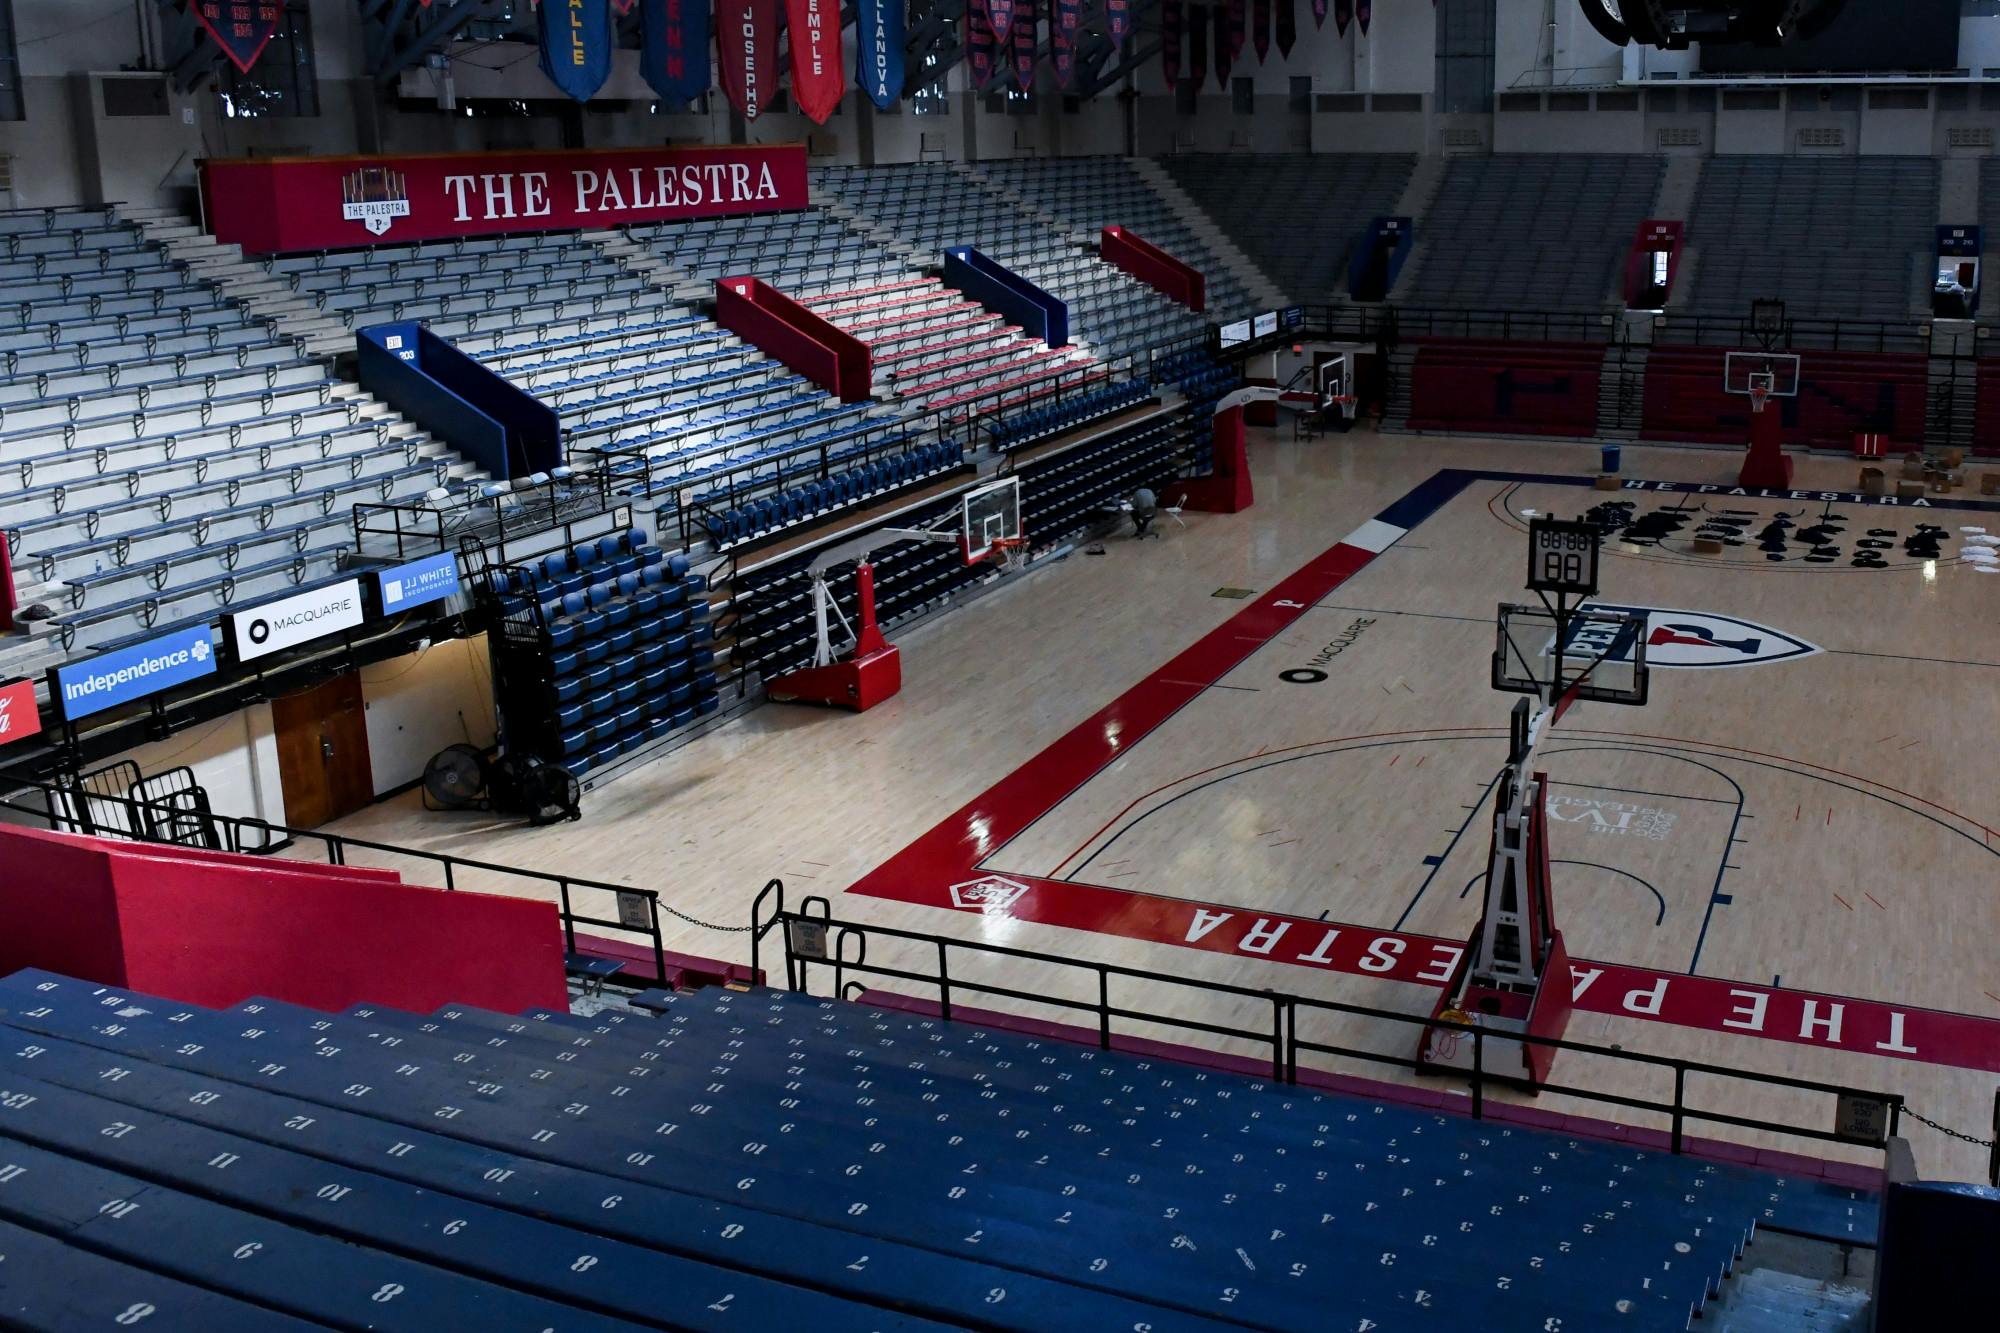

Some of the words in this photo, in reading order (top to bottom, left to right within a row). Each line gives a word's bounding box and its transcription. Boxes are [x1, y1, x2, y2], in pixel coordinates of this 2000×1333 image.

[444, 171, 551, 222] THE
[571, 161, 779, 214] PALESTRA
[348, 205, 363, 217] THE
[366, 203, 406, 216] PALESTRA
[375, 219, 382, 231] P
[1698, 484, 1933, 507] PALESTRA
[404, 576, 417, 590] JJ
[419, 566, 452, 584] WHITE
[404, 578, 454, 598] INCORPORATED
[273, 598, 352, 632] MACQUARIE
[1567, 608, 1630, 656] PEN
[1306, 617, 1377, 667] MACQUARIE
[65, 648, 189, 701] Independence
[1184, 907, 1671, 1017] PAESTRA
[1722, 989, 1920, 1055] THE
[17, 1046, 46, 1058] 15
[99, 1068, 130, 1081] 14
[344, 1084, 372, 1096] 13
[2, 1094, 37, 1108] 13
[189, 1091, 220, 1104] 13
[435, 1106, 463, 1118] 12
[101, 1122, 136, 1137] 12
[285, 1116, 316, 1129] 12
[387, 1142, 415, 1156] 11
[208, 1153, 240, 1168] 11
[627, 1152, 655, 1165] 10
[0, 1165, 26, 1182] 11
[484, 1168, 515, 1182] 10
[737, 1178, 755, 1189] 9
[317, 1184, 352, 1201] 10
[948, 1187, 966, 1198] 8
[602, 1195, 622, 1208] 9
[100, 1200, 139, 1218] 10
[848, 1203, 868, 1215] 8
[443, 1220, 467, 1235] 9
[721, 1224, 744, 1238] 8
[964, 1231, 982, 1243] 7
[1170, 1235, 1187, 1249] 6
[234, 1243, 262, 1259] 9
[571, 1256, 598, 1272] 8
[847, 1256, 869, 1271] 7
[1090, 1258, 1107, 1271] 6
[1290, 1263, 1307, 1276] 5
[372, 1284, 404, 1302] 8
[985, 1288, 1005, 1303] 6
[1220, 1288, 1239, 1302] 5
[1415, 1290, 1431, 1306] 4
[708, 1294, 734, 1311] 7
[116, 1303, 155, 1324] 8
[1358, 1319, 1376, 1332] 4
[1545, 1318, 1561, 1332] 3
